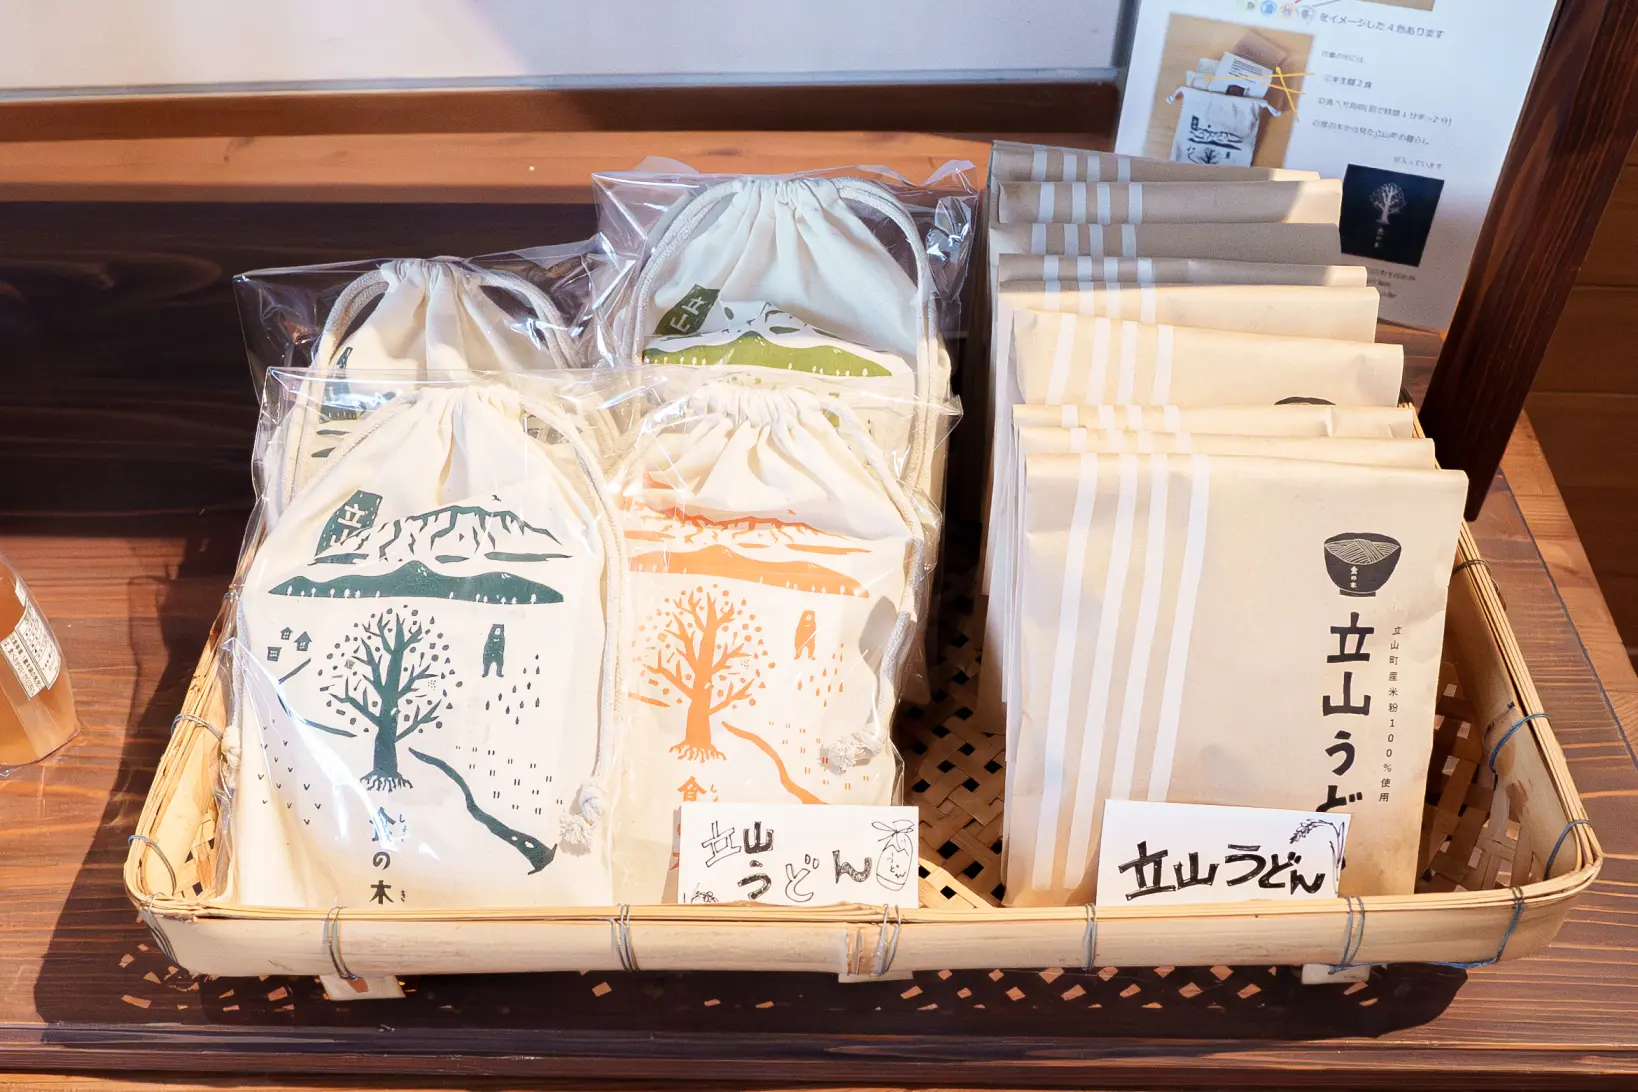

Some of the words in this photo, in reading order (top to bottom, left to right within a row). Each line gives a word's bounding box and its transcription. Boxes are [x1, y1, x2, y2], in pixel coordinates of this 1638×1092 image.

[1315, 611, 1374, 870] 立山うど
[1379, 626, 1402, 802] 立山町産米粉100%使用
[1118, 840, 1326, 901] 立山うどん
